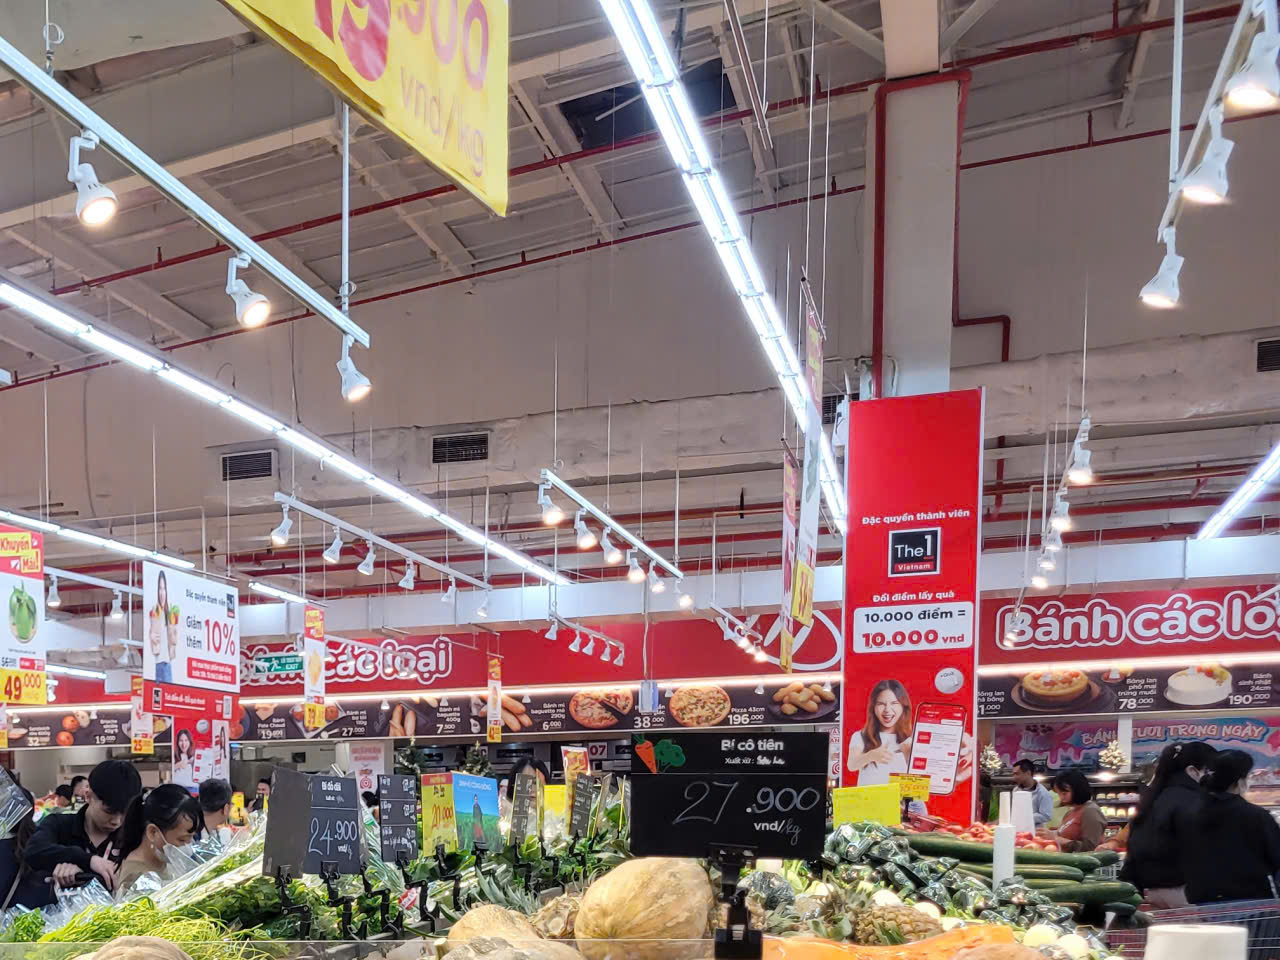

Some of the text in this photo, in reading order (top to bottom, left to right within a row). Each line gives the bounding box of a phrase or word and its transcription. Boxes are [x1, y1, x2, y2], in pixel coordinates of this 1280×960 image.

[401, 66, 484, 177] vnd/kg
[862, 508, 970, 525] Đặc quyền thành viên
[0, 535, 30, 553] Khuyến
[898, 562, 931, 571] Vietnam
[892, 592, 916, 601] điểm
[864, 611, 913, 623] 10.000
[918, 607, 953, 620] điểm
[1004, 597, 1280, 641] Bánh các lo
[205, 618, 236, 657] 10%
[862, 629, 965, 648] 10.000 vnd
[383, 643, 446, 679] loại
[1119, 697, 1154, 709] 78.000
[1228, 693, 1271, 705] 190.000
[633, 716, 665, 728] 38.000
[727, 714, 765, 725] 196.000
[341, 727, 365, 737] 27.000
[1168, 724, 1218, 737] TRONG
[1222, 721, 1265, 738] NGÀY
[589, 743, 607, 756] 07
[721, 738, 784, 751] Bí cô tiên
[725, 756, 741, 764] Xuất
[672, 781, 820, 825] 27.900
[308, 817, 358, 855] 24.900
[754, 817, 802, 846] vnd/kg
